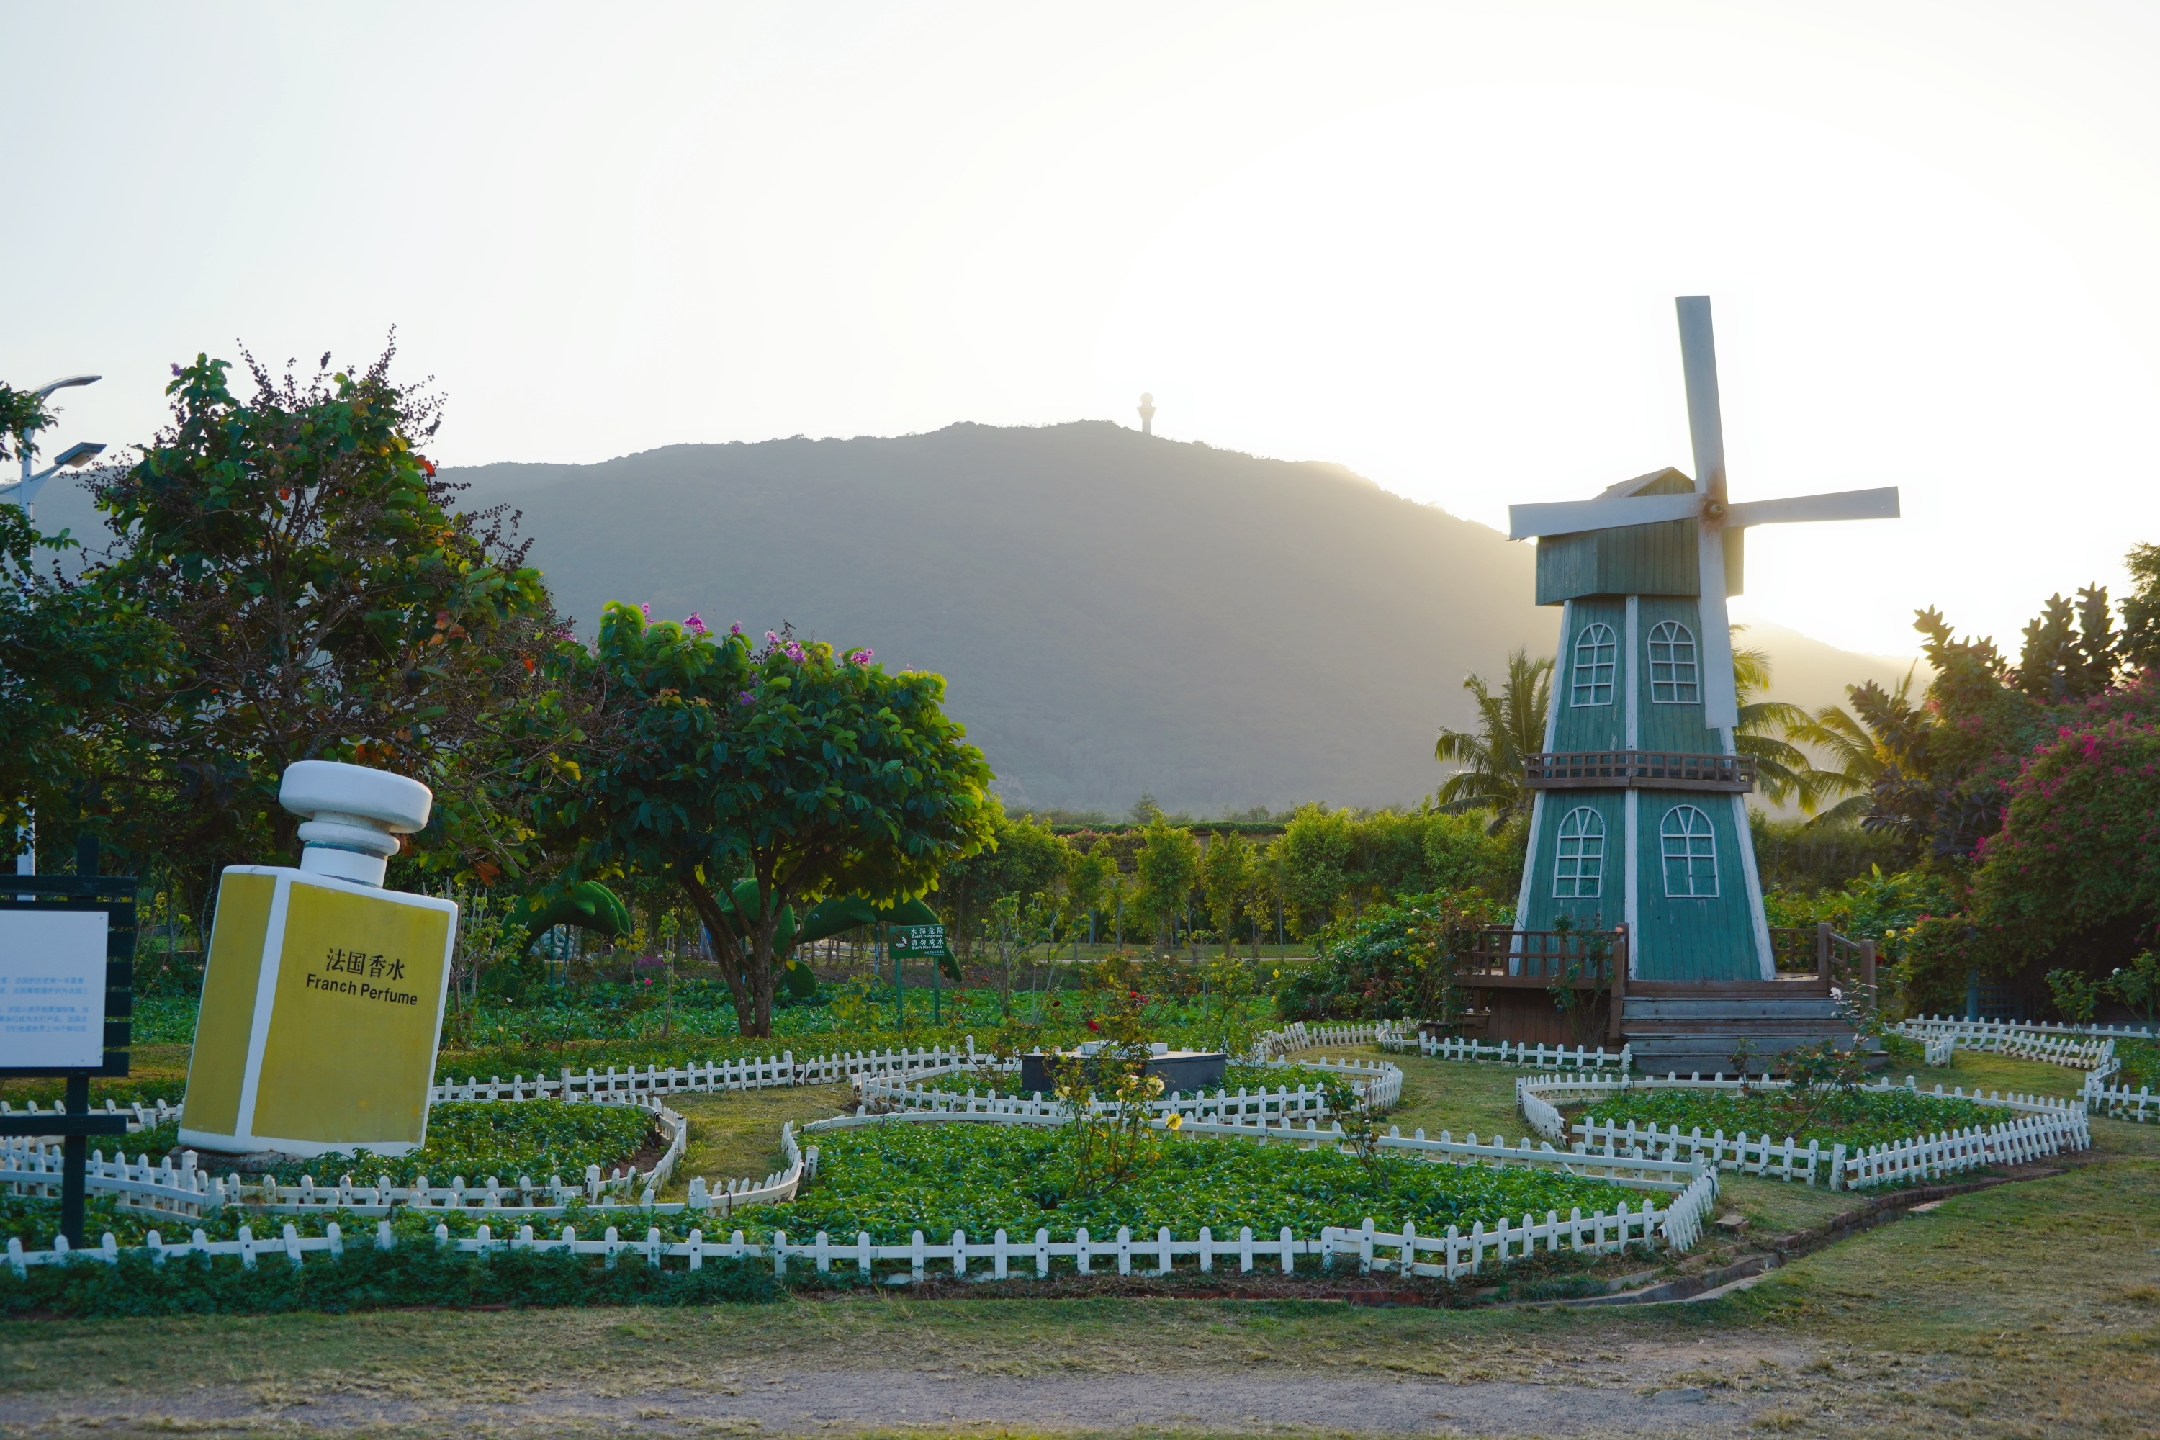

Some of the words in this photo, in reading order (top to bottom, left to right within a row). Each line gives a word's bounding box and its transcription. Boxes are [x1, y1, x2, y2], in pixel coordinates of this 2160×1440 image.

[326, 948, 405, 981] 法国香水
[306, 973, 357, 996] Franch
[360, 983, 418, 1006] Perfume
